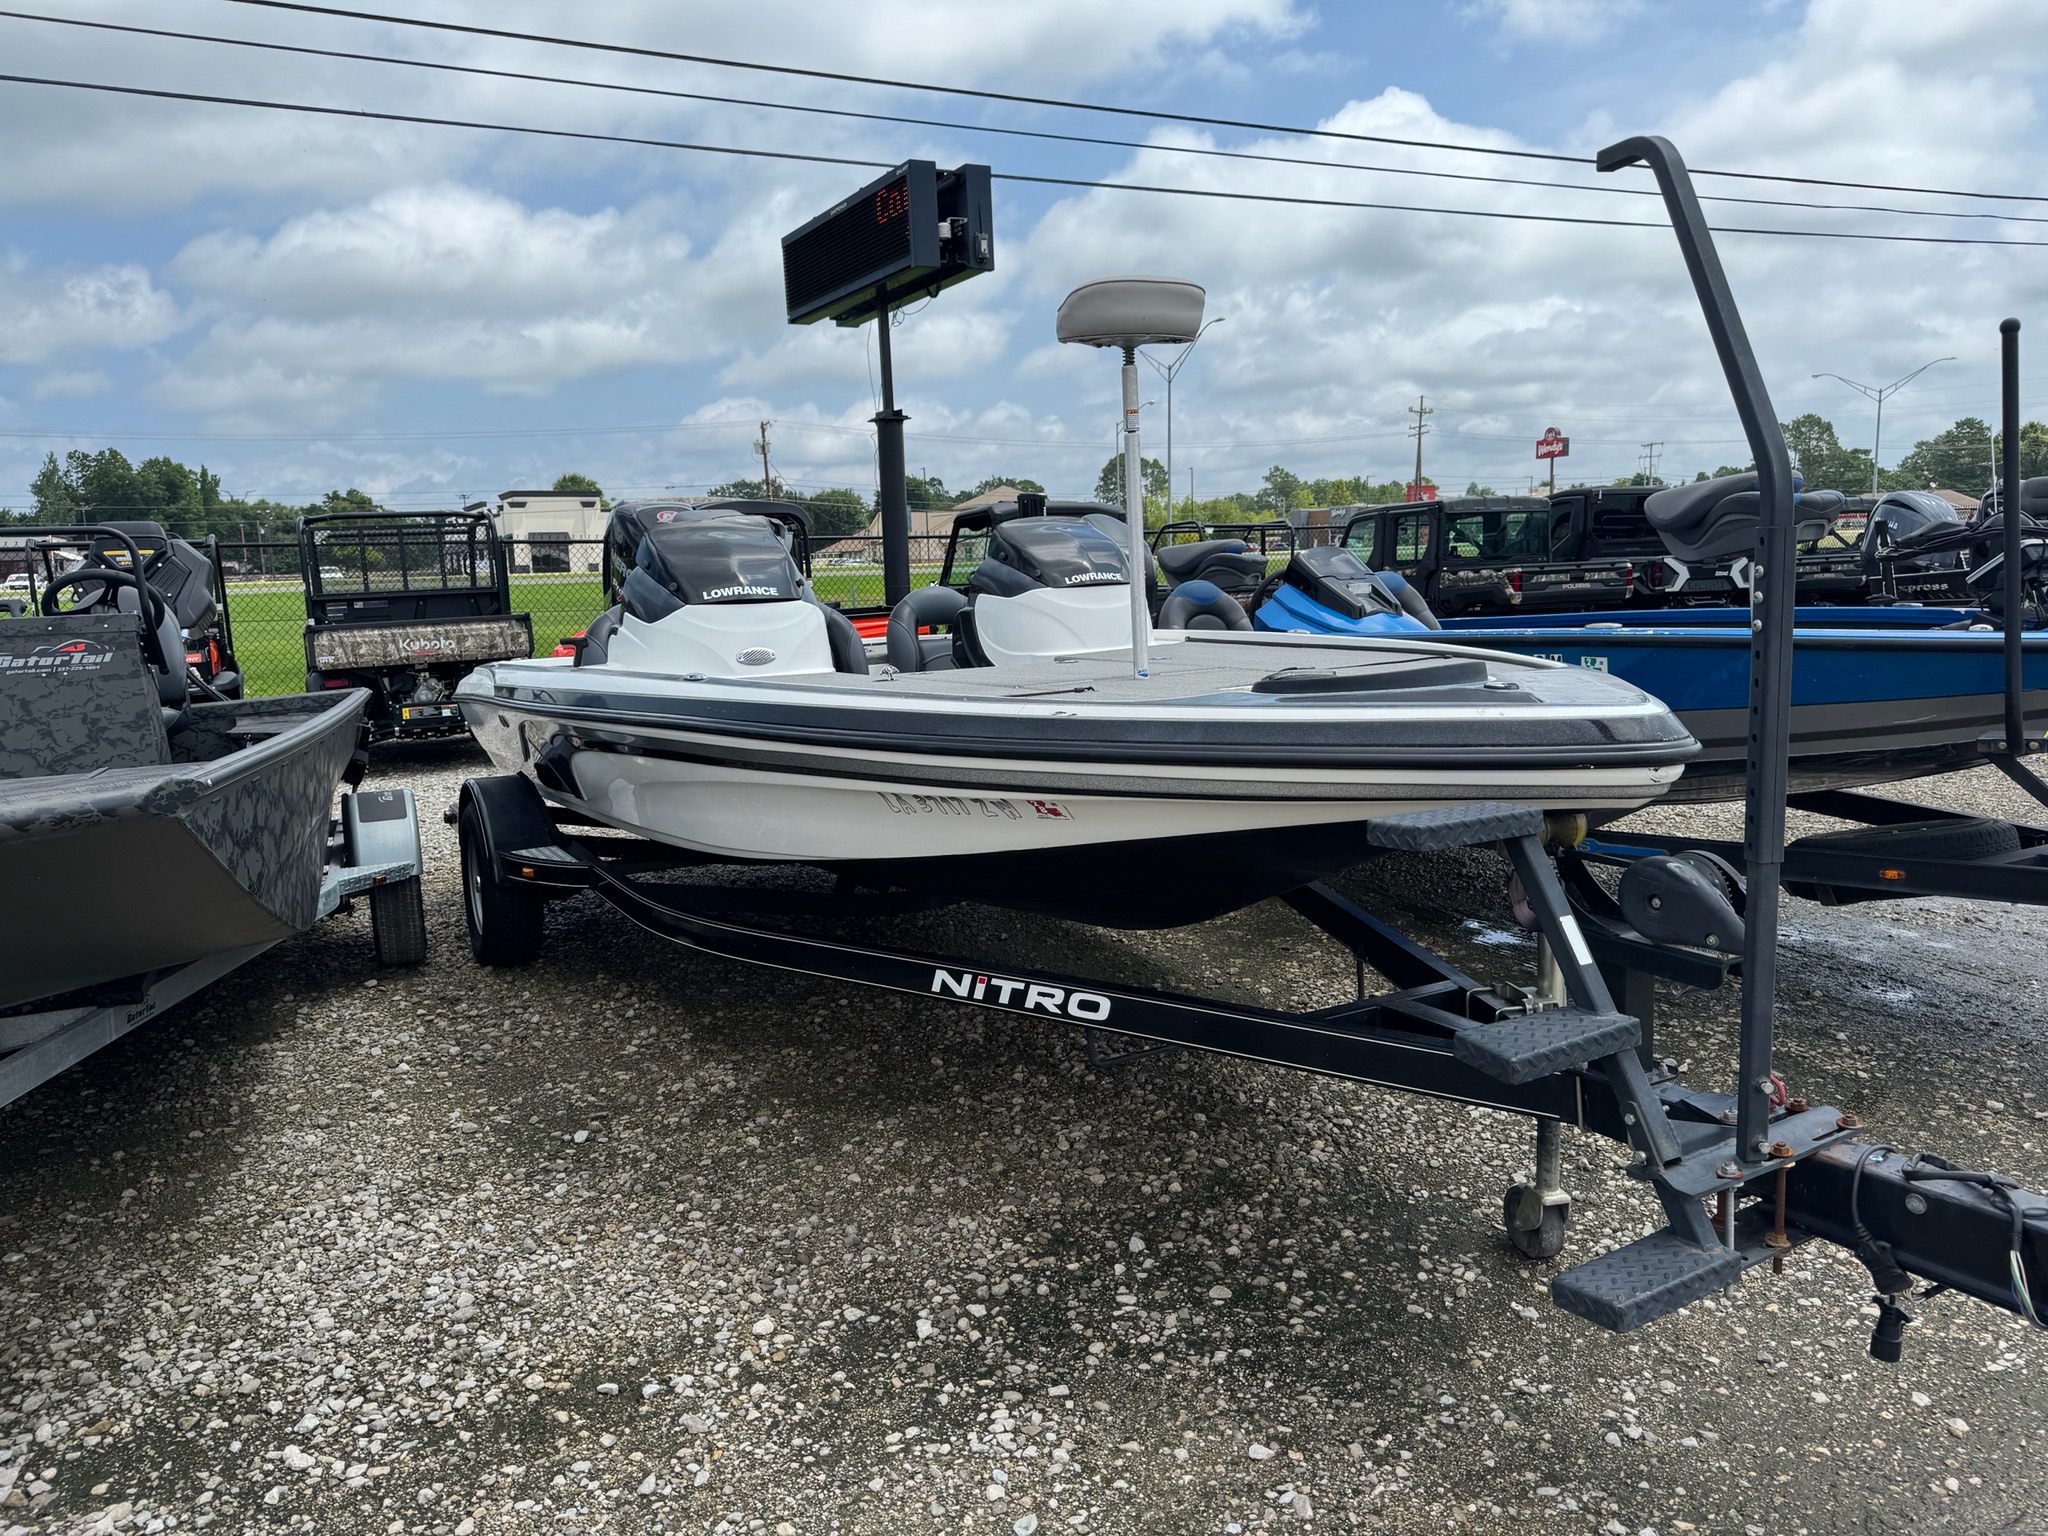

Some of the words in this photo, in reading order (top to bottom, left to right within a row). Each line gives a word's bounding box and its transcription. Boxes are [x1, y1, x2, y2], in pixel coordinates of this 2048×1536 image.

[1537, 440, 1563, 457] Wendy's
[1064, 571, 1124, 585] LOWRANCE
[702, 586, 779, 600] LOWRANCE
[399, 636, 455, 651] Kubota
[0, 651, 114, 669] GatorTail
[876, 791, 918, 815] LA
